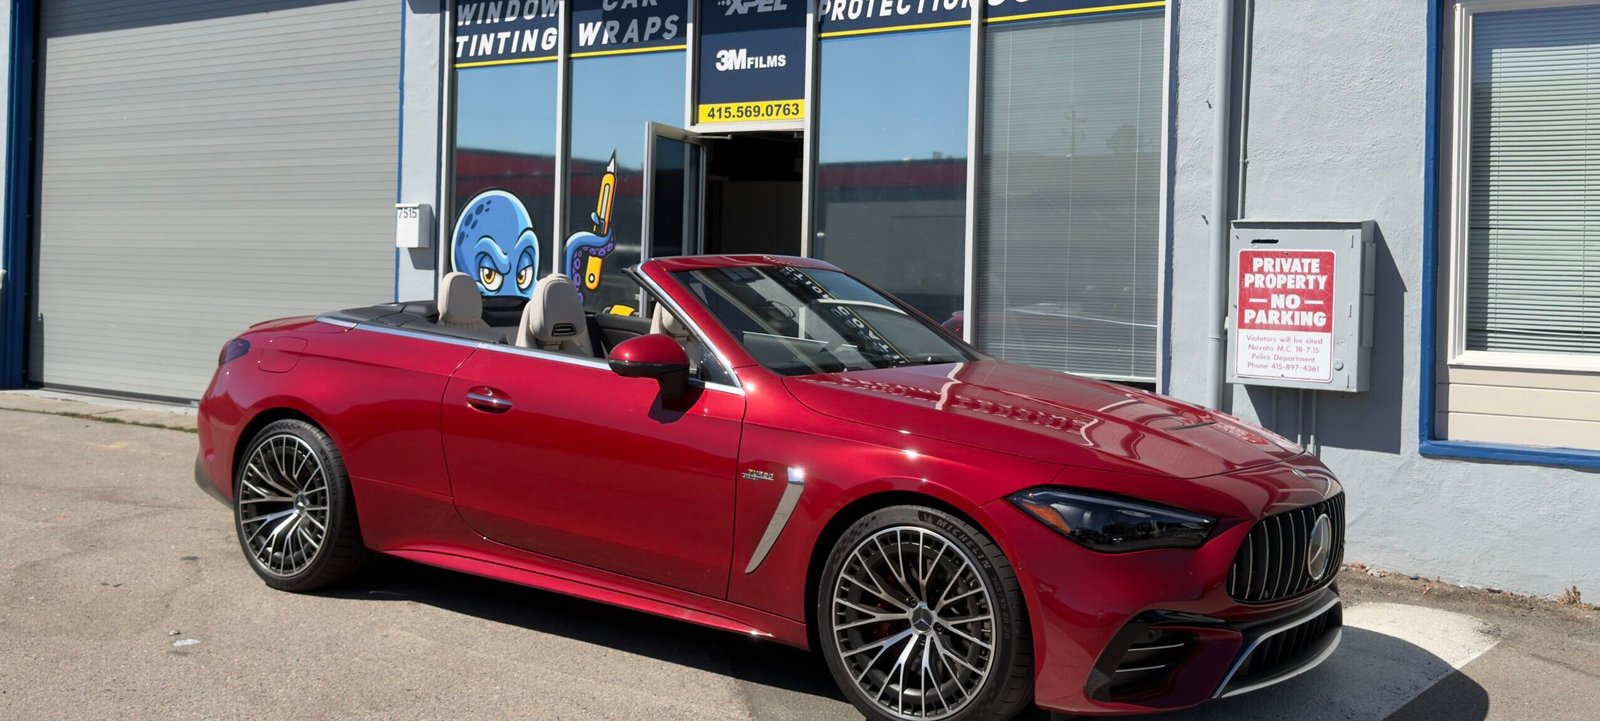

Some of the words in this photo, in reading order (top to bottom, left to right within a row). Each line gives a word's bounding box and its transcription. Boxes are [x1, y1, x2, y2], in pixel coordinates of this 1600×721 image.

[458, 0, 559, 26] WINDOW
[579, 14, 680, 47] WRAPS
[456, 27, 558, 58] TINTING
[715, 48, 747, 72] 3M
[747, 54, 787, 69] FILMS
[707, 103, 800, 119] 415.569.0763
[1252, 257, 1320, 273] PRIVATE
[1244, 274, 1328, 290] PROPERTY
[1270, 294, 1301, 309] NO
[1244, 309, 1327, 327] PARKING
[1246, 334, 1277, 342] Violators
[1294, 336, 1302, 344] be
[1306, 337, 1323, 345] cited
[1274, 354, 1316, 363] Department
[1271, 363, 1320, 372] 415-897-4361
[937, 518, 992, 569] MICHELIN
